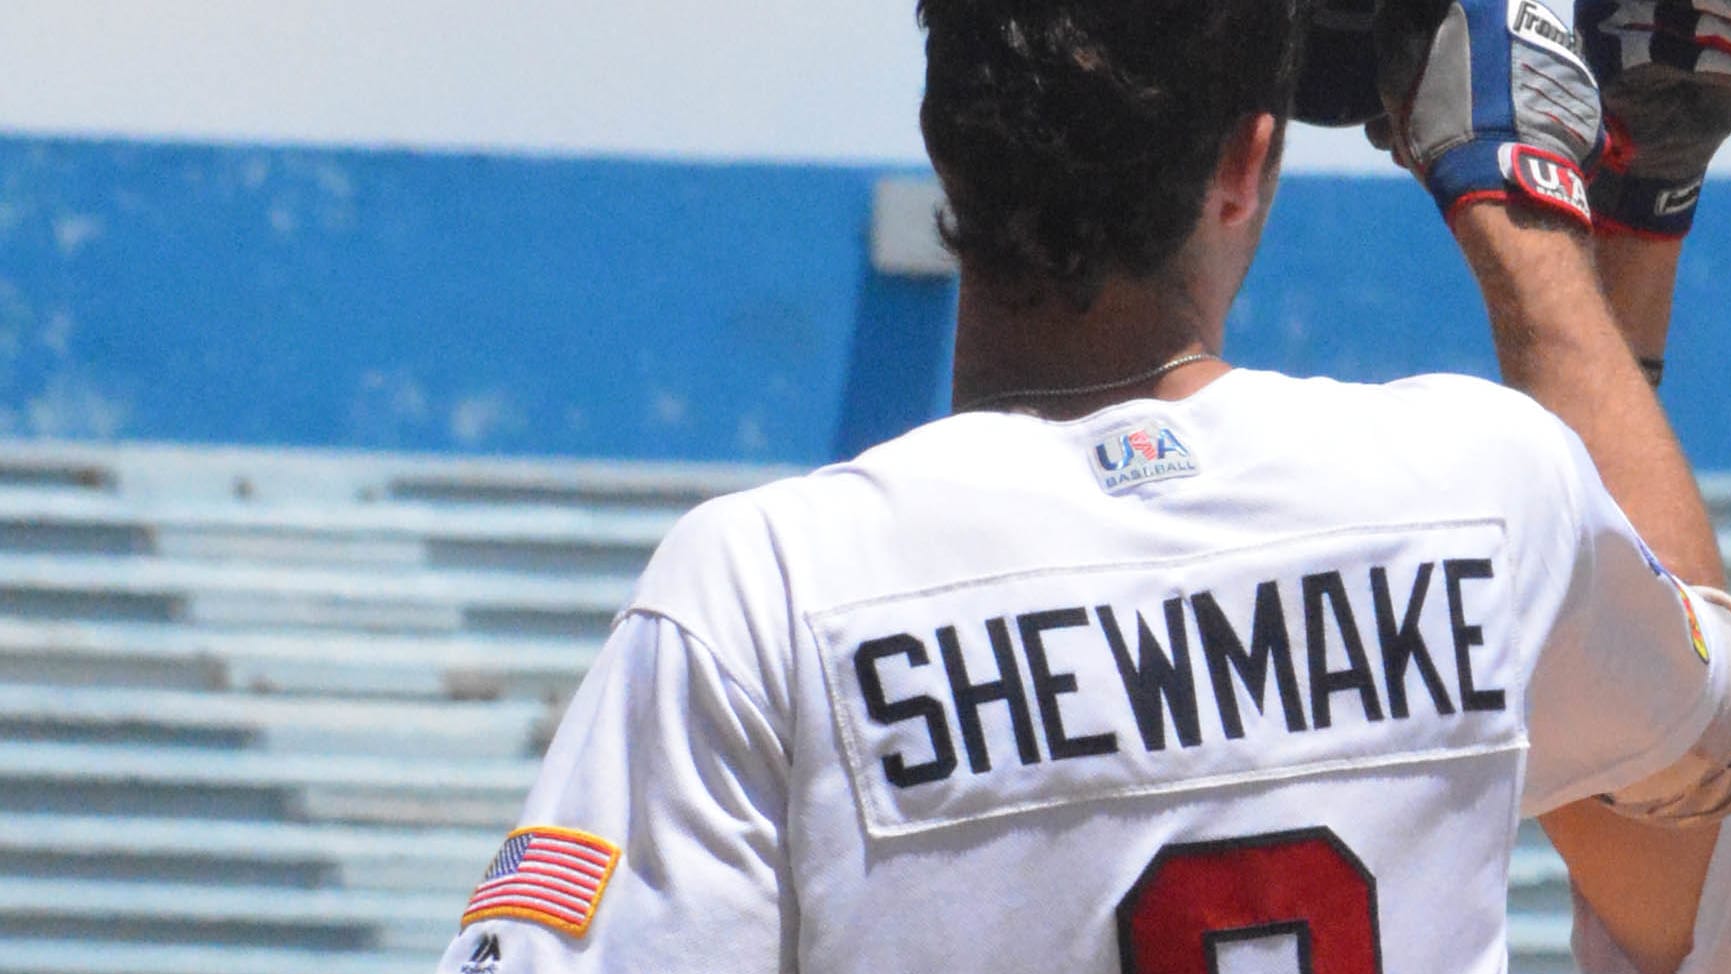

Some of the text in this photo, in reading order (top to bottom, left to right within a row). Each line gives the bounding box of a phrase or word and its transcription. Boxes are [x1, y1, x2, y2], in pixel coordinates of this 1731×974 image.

[1095, 428, 1190, 471] USA
[1104, 460, 1197, 489] BASEBALL
[852, 558, 1507, 789] SHEWMAKE
